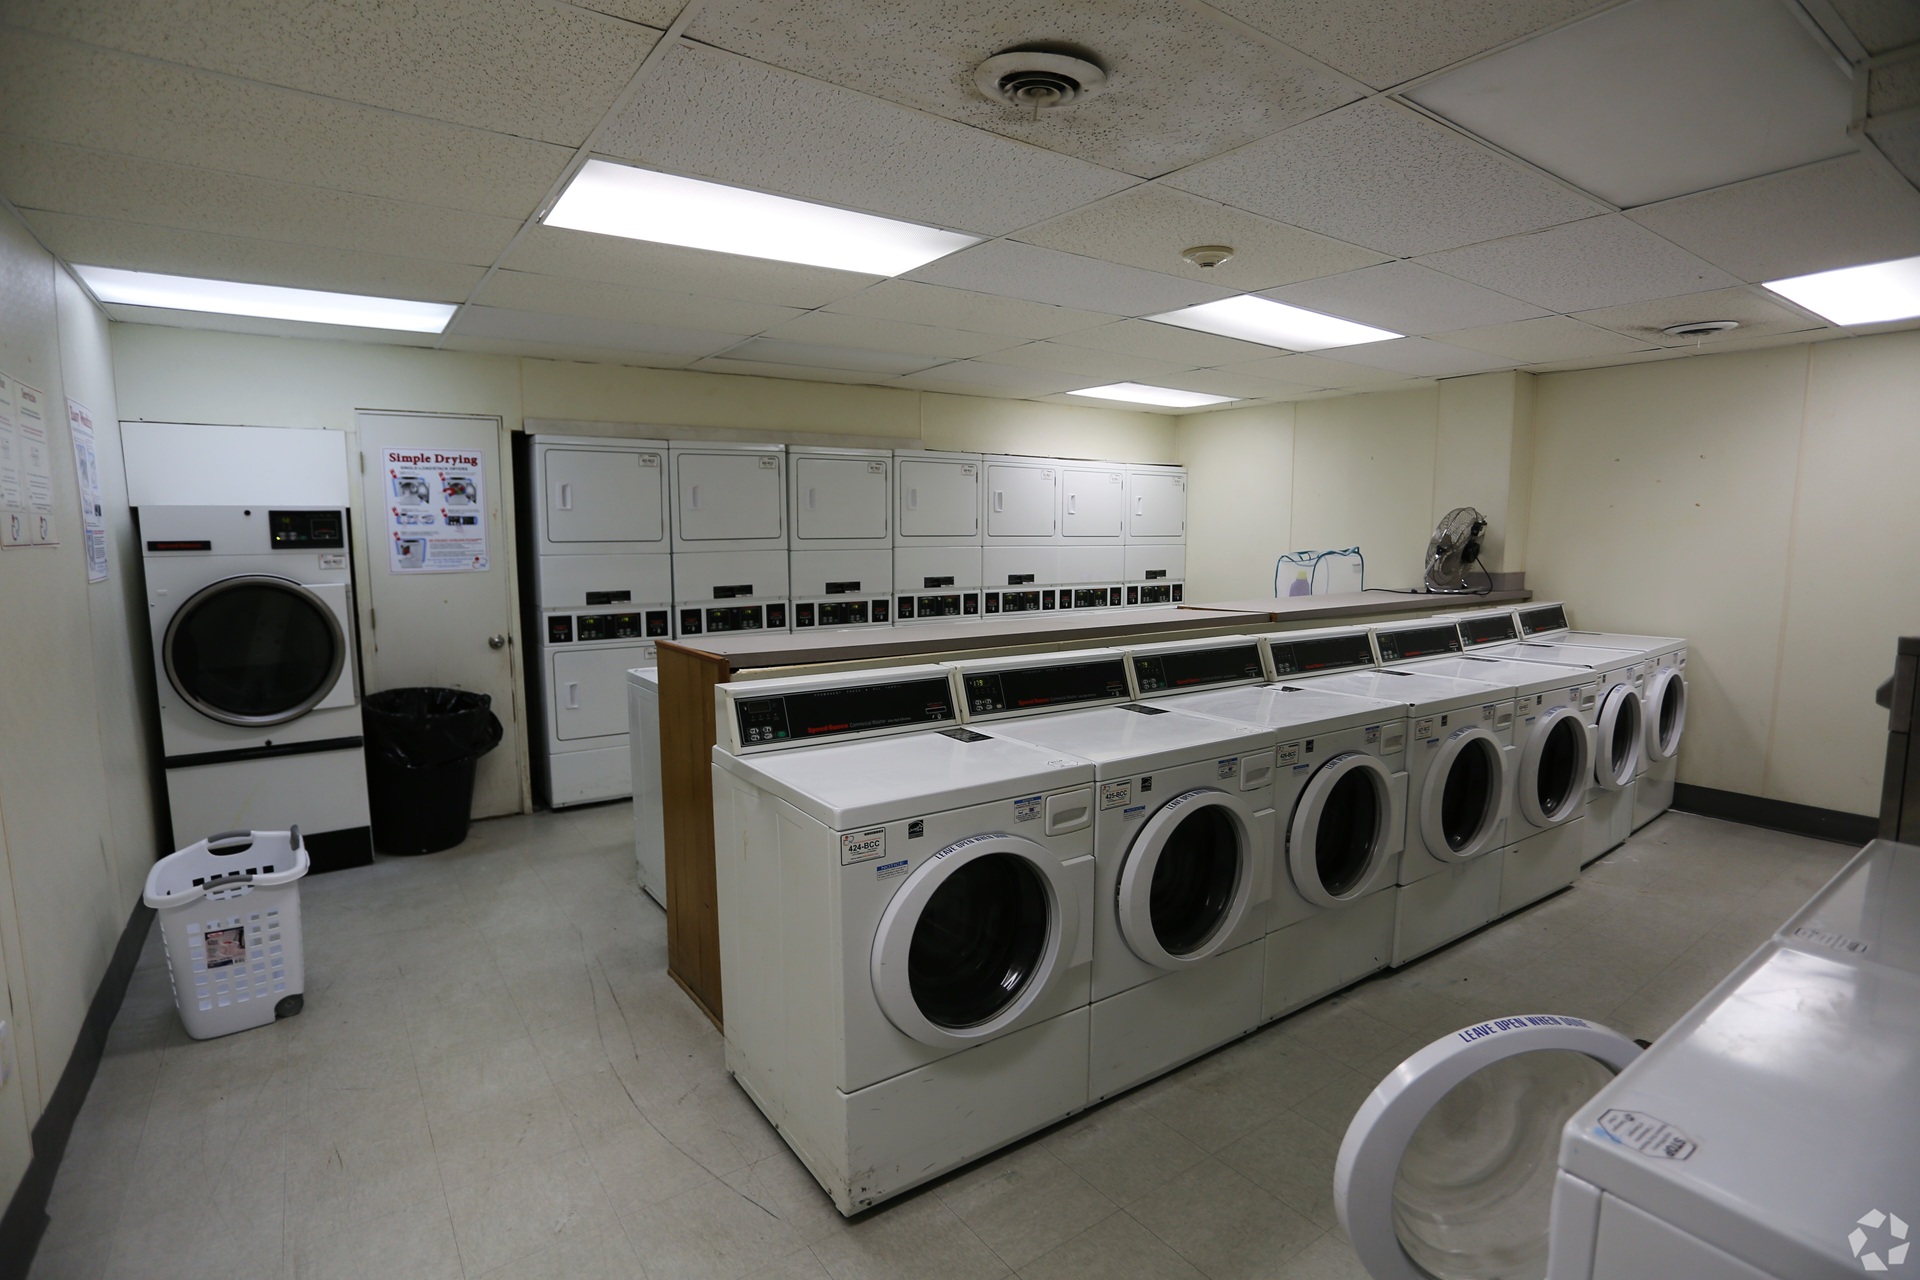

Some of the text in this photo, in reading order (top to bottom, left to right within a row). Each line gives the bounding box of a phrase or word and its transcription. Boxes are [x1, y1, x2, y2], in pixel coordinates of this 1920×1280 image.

[389, 453, 478, 467] Simple Drying
[808, 725, 828, 734] Speed
[1105, 790, 1128, 800] 425-BCC
[848, 840, 880, 852] 424-BCC
[934, 846, 958, 860] LEAVE
[955, 838, 975, 849] OPEN
[1458, 1023, 1498, 1043] LEAVE
[1494, 1017, 1528, 1032] OPEN
[1524, 1016, 1562, 1026] WHEN
